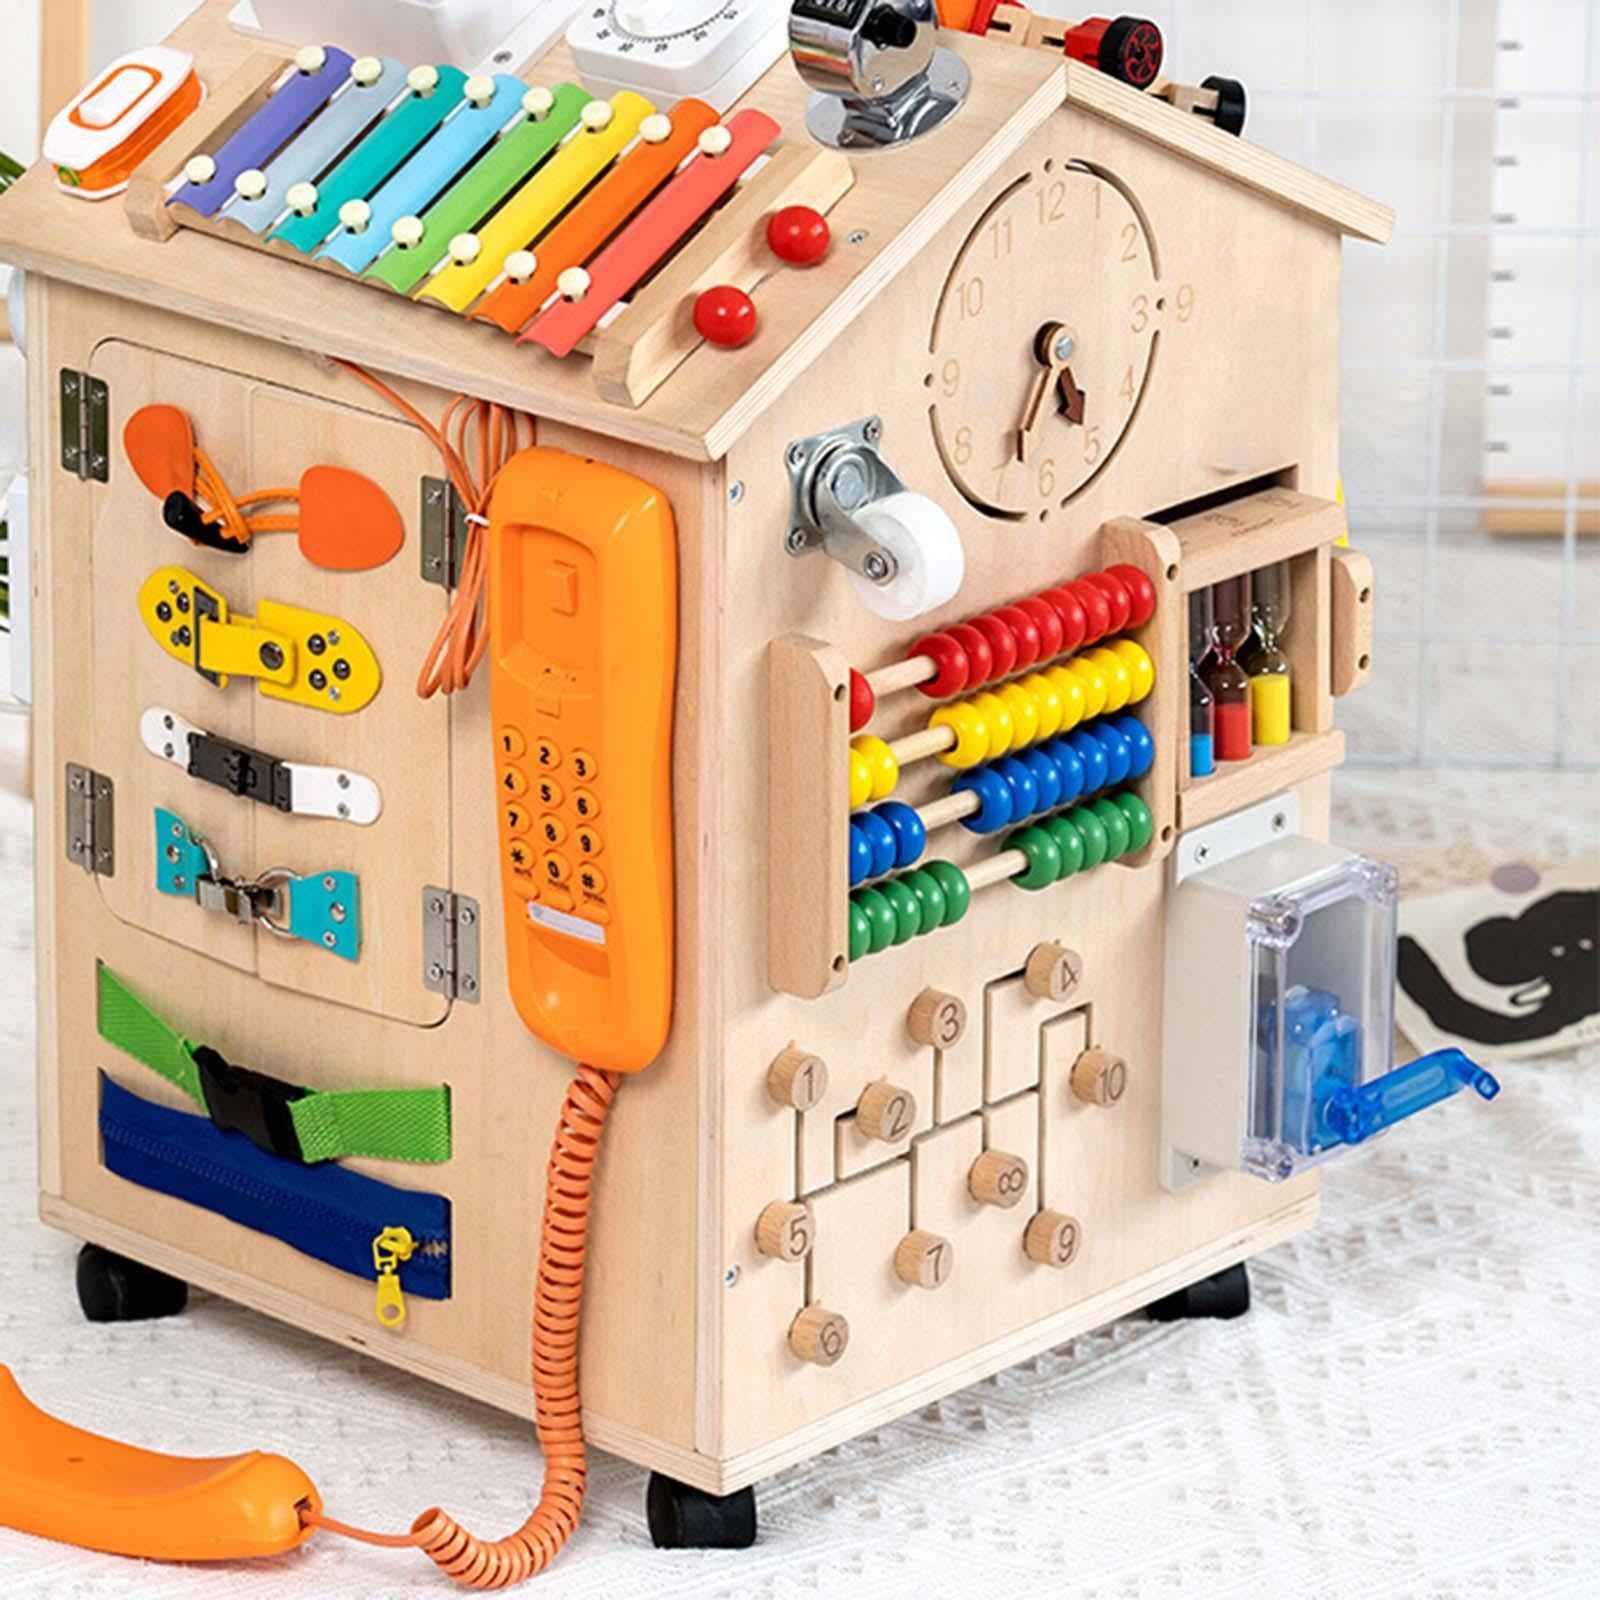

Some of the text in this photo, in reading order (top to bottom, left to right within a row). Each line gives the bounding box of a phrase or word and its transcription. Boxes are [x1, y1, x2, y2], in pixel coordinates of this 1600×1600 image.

[1036, 181, 1066, 224] 12
[1091, 184, 1101, 219] 1
[989, 216, 1013, 258] 11
[1120, 223, 1138, 263] 2
[957, 276, 984, 320] 10
[1131, 294, 1149, 334] 3
[1176, 284, 1194, 323] 9
[942, 359, 960, 398] 9
[1121, 366, 1134, 401] 4
[954, 426, 973, 465] 8
[1083, 426, 1100, 466] 5
[1039, 458, 1055, 497] 6
[503, 736, 511, 752] 1
[539, 746, 550, 765] 2
[504, 773, 515, 791] 4
[575, 758, 586, 777] 3
[540, 784, 551, 803] 5
[577, 798, 588, 816] 6
[508, 811, 519, 828] 7
[545, 824, 557, 843] 8
[580, 834, 592, 853] 9
[547, 861, 560, 878] 0
[581, 873, 595, 890] #
[1060, 960, 1079, 992] 4
[939, 1002, 961, 1042] 3
[802, 1065, 815, 1102] 1
[1100, 1063, 1126, 1101] 10
[884, 1096, 906, 1136] 2
[998, 1166, 1025, 1195] 8
[789, 1215, 808, 1256] 5
[1058, 1223, 1076, 1262] 9
[926, 1244, 945, 1282] 7
[819, 1320, 842, 1357] 6
